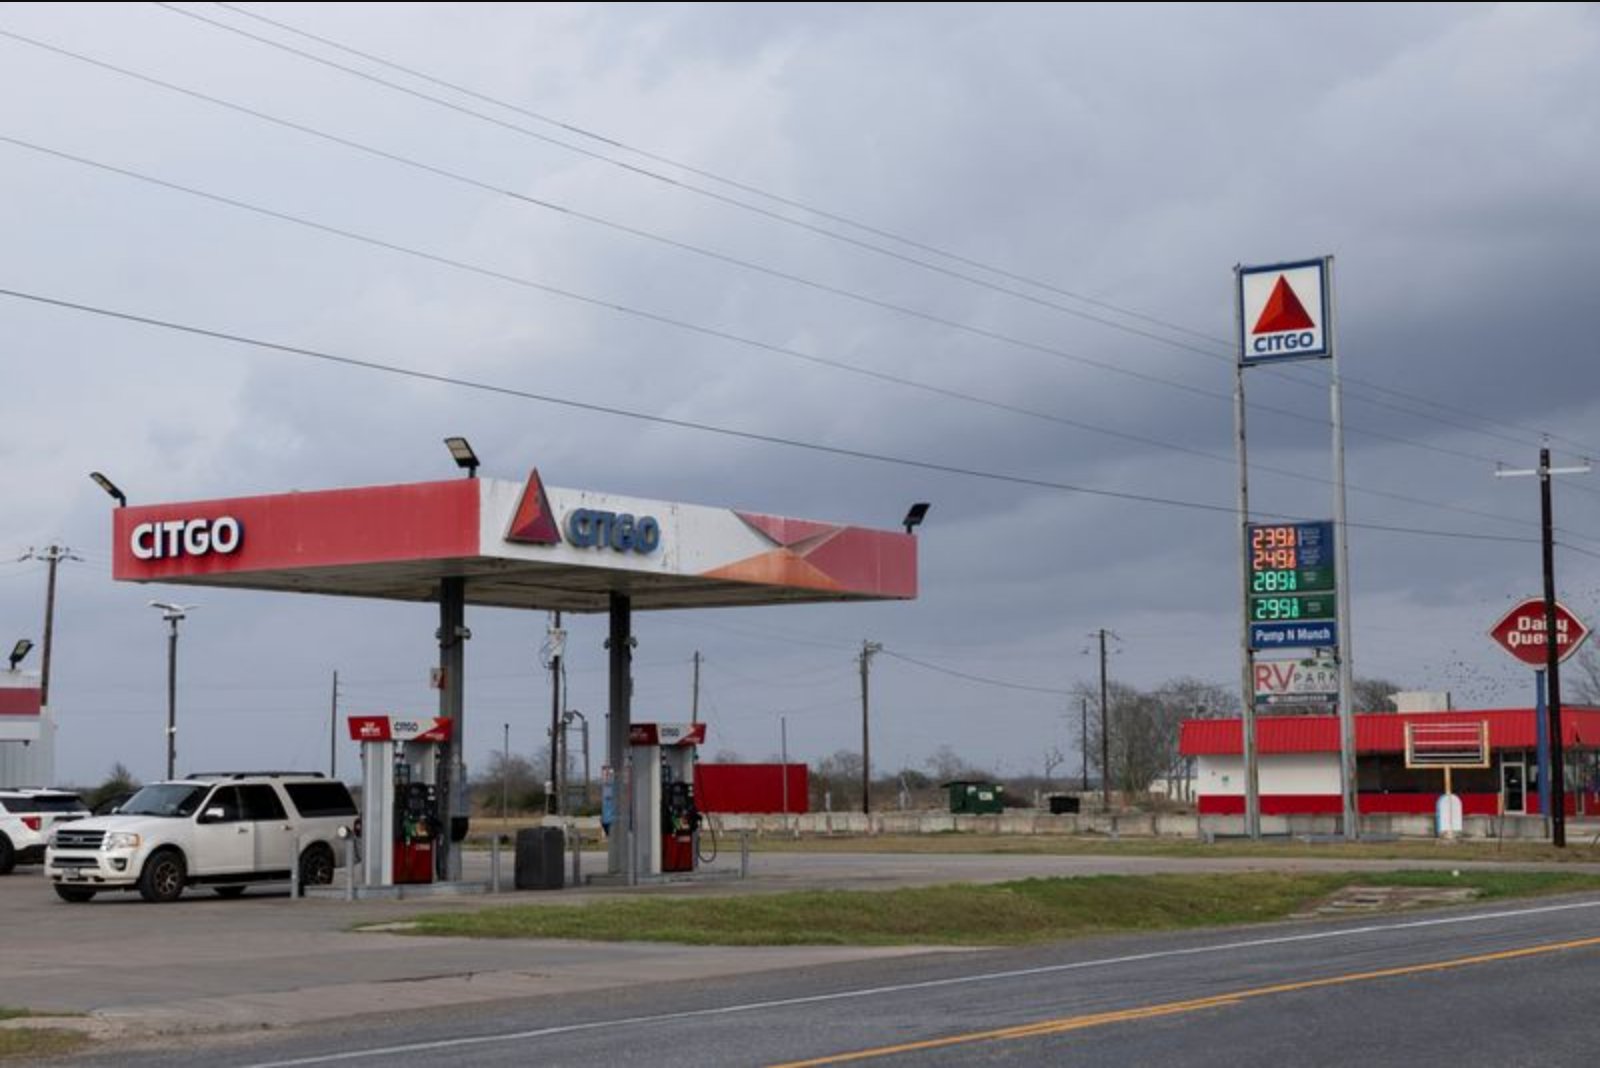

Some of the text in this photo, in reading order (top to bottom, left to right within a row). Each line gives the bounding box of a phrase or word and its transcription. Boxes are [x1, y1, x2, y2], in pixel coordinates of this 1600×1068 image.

[1253, 332, 1315, 352] CITGO
[130, 516, 241, 560] CITGO
[566, 507, 661, 554] CITGO
[1517, 613, 1569, 633] Daiy
[1255, 627, 1332, 643] Pump N Munch
[1507, 631, 1569, 648] Quen
[1255, 663, 1296, 692] RV
[1293, 671, 1338, 683] PARK
